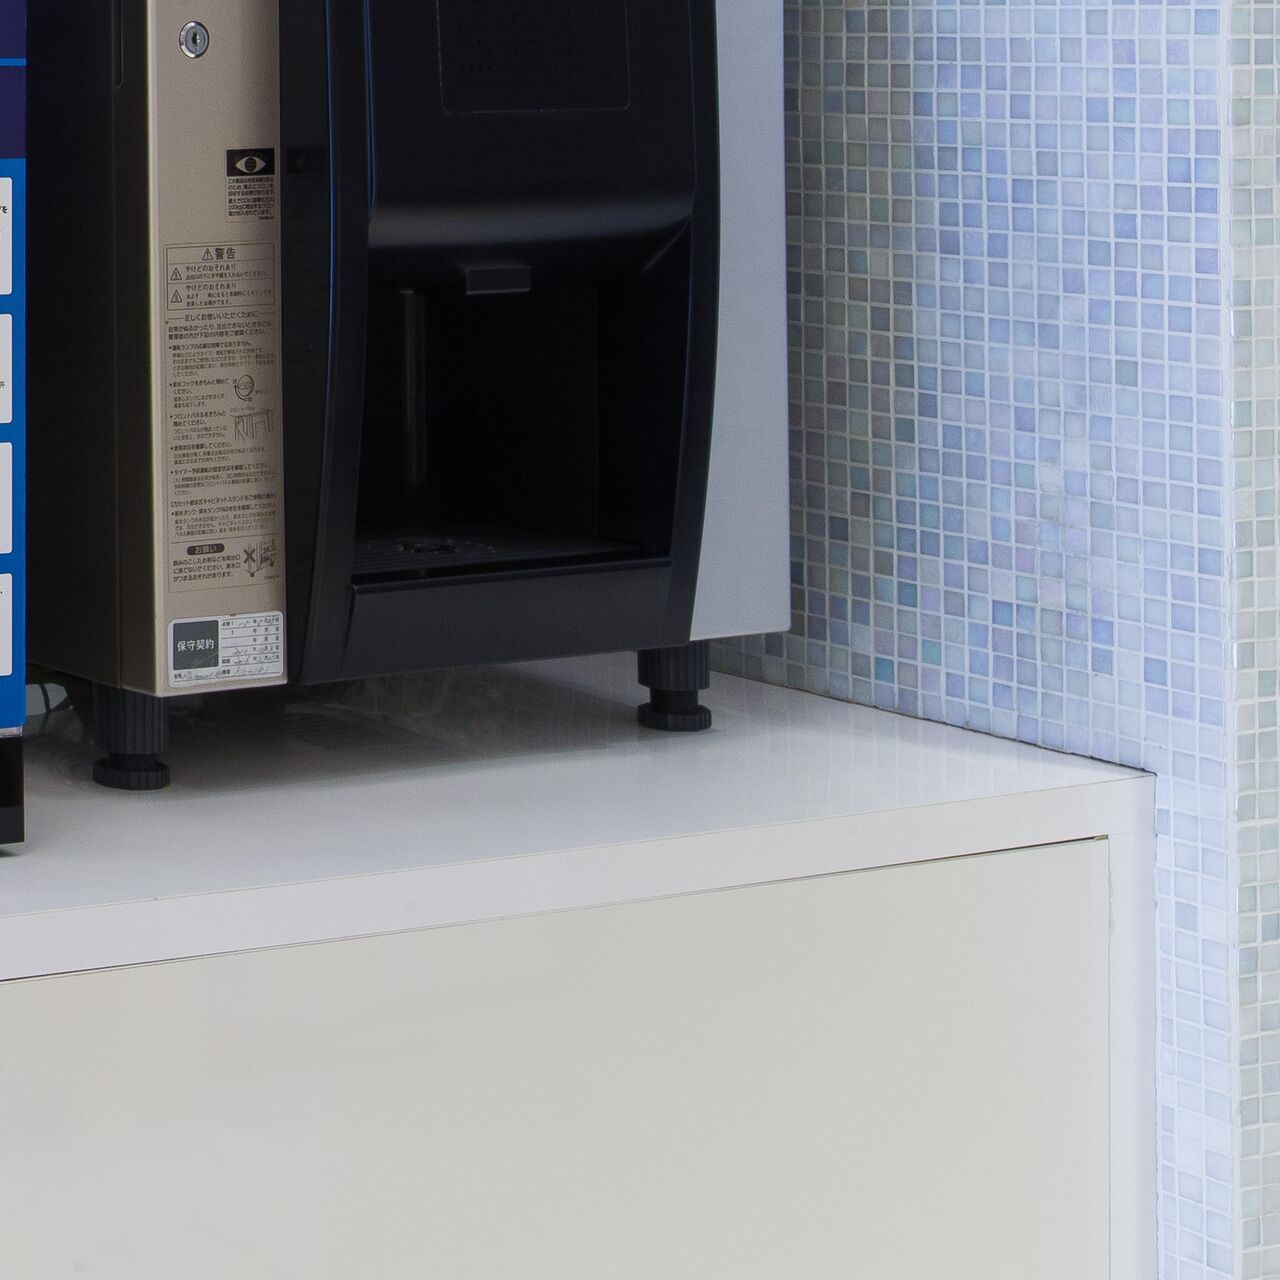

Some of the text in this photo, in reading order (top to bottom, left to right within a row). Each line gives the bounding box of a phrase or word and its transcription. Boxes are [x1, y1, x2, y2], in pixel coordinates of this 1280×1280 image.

[214, 248, 236, 260] 警告
[177, 639, 214, 652] 保守契約
